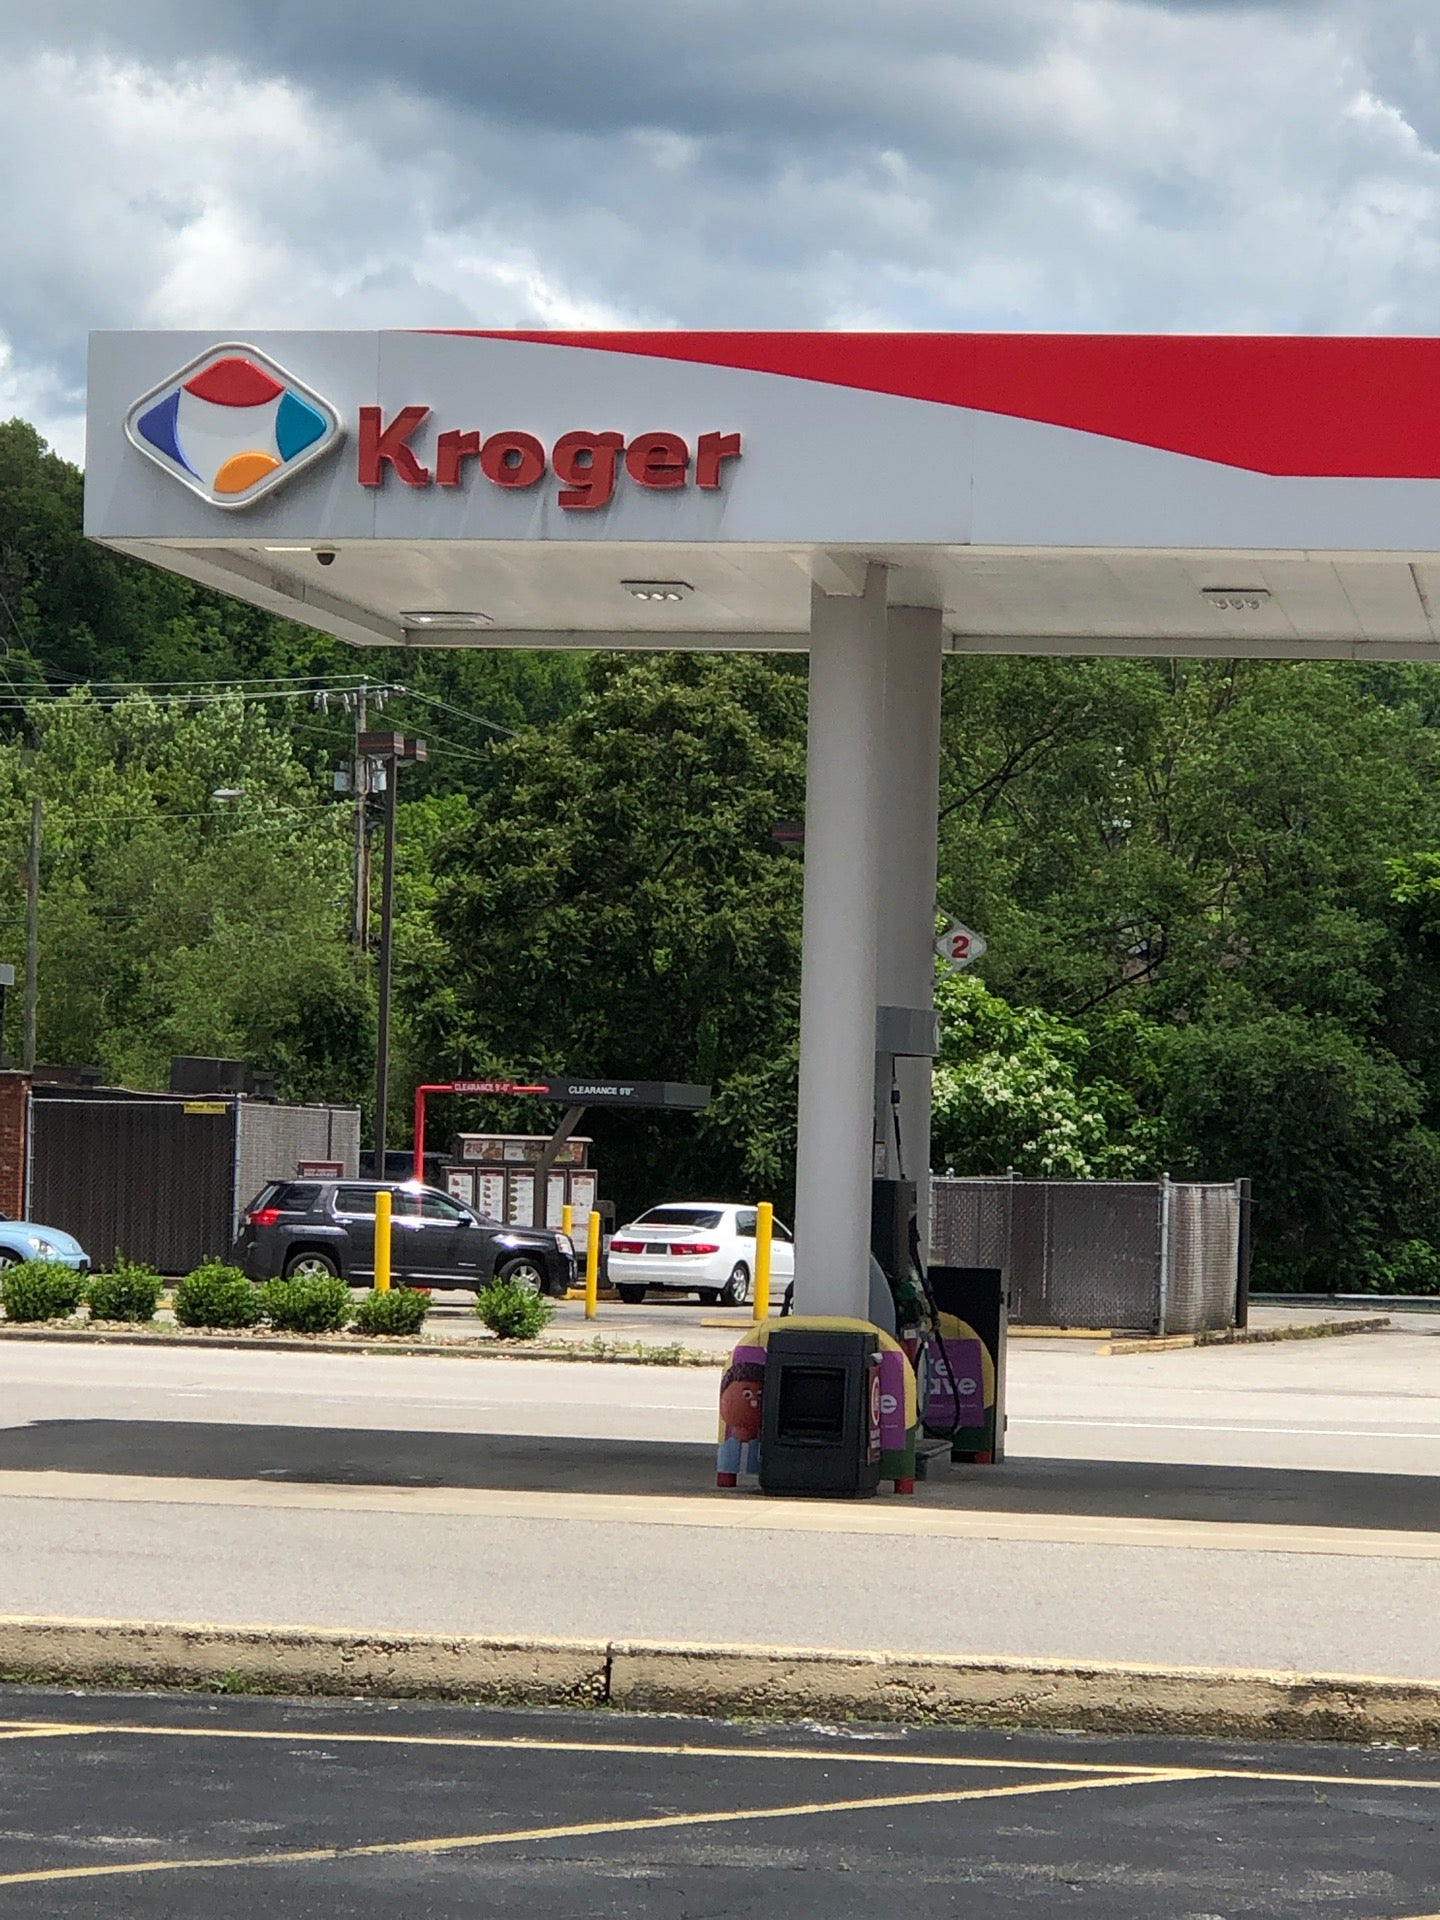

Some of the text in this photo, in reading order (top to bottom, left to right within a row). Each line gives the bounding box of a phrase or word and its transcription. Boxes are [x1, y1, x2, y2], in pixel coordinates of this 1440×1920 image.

[358, 405, 742, 510] Kroger
[951, 935, 970, 959] 2
[454, 1083, 494, 1092] CLEARANCE
[568, 1085, 617, 1095] CLEARANCE
